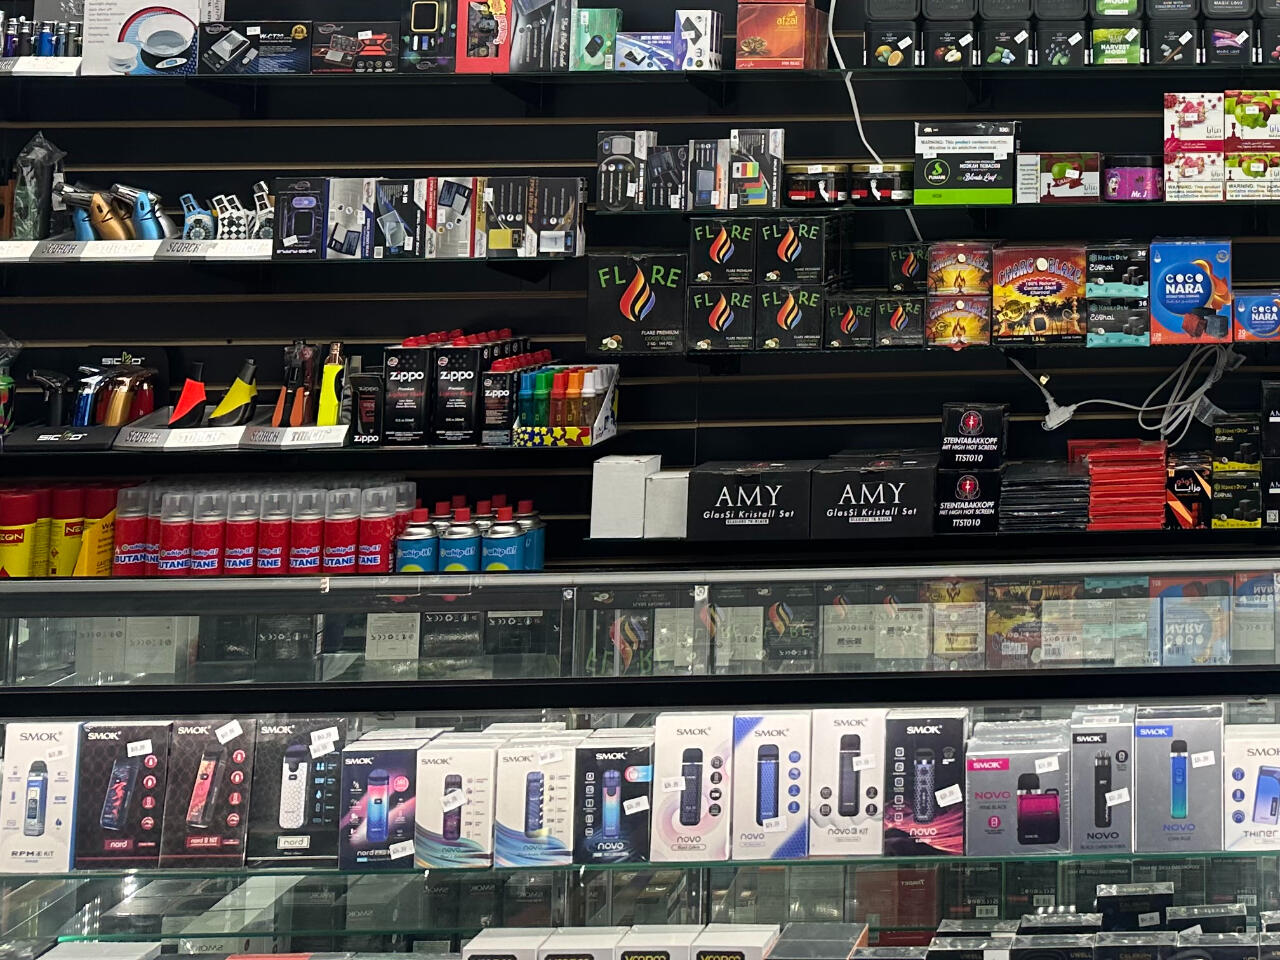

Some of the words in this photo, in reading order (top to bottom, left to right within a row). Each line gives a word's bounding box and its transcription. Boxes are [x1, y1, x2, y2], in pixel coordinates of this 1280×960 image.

[777, 15, 798, 25] afzal
[1166, 273, 1204, 283] COCO
[1166, 283, 1204, 294] NARA
[390, 371, 424, 382] zippo
[440, 371, 474, 382] zippo
[485, 389, 509, 398] zippo
[354, 435, 379, 444] zippo
[955, 454, 984, 462] TTST010
[715, 485, 782, 507] AMY
[838, 483, 906, 505] AMY
[704, 511, 734, 519] GlasSi
[739, 510, 775, 518] Kristall
[779, 510, 795, 518] Set
[827, 509, 858, 517] GlasSi
[861, 508, 898, 516] Kristall
[953, 519, 981, 527] TTST010
[403, 548, 433, 558] whip-it!
[445, 546, 476, 557] whip-it!
[487, 546, 518, 556] whip-it!
[358, 555, 380, 566] TANE
[178, 727, 209, 735] SMOK
[261, 726, 293, 735] SMOK
[677, 728, 708, 736] SMOK
[907, 726, 940, 734] SMOK
[1140, 728, 1168, 736] SMOK
[20, 733, 58, 741] SMOK
[88, 732, 119, 740] SMOK
[1076, 735, 1102, 743] SMOK
[974, 761, 1001, 769] SMOK
[974, 791, 1011, 800] NOVO
[910, 828, 938, 836] novo
[1087, 832, 1120, 840] NOVO
